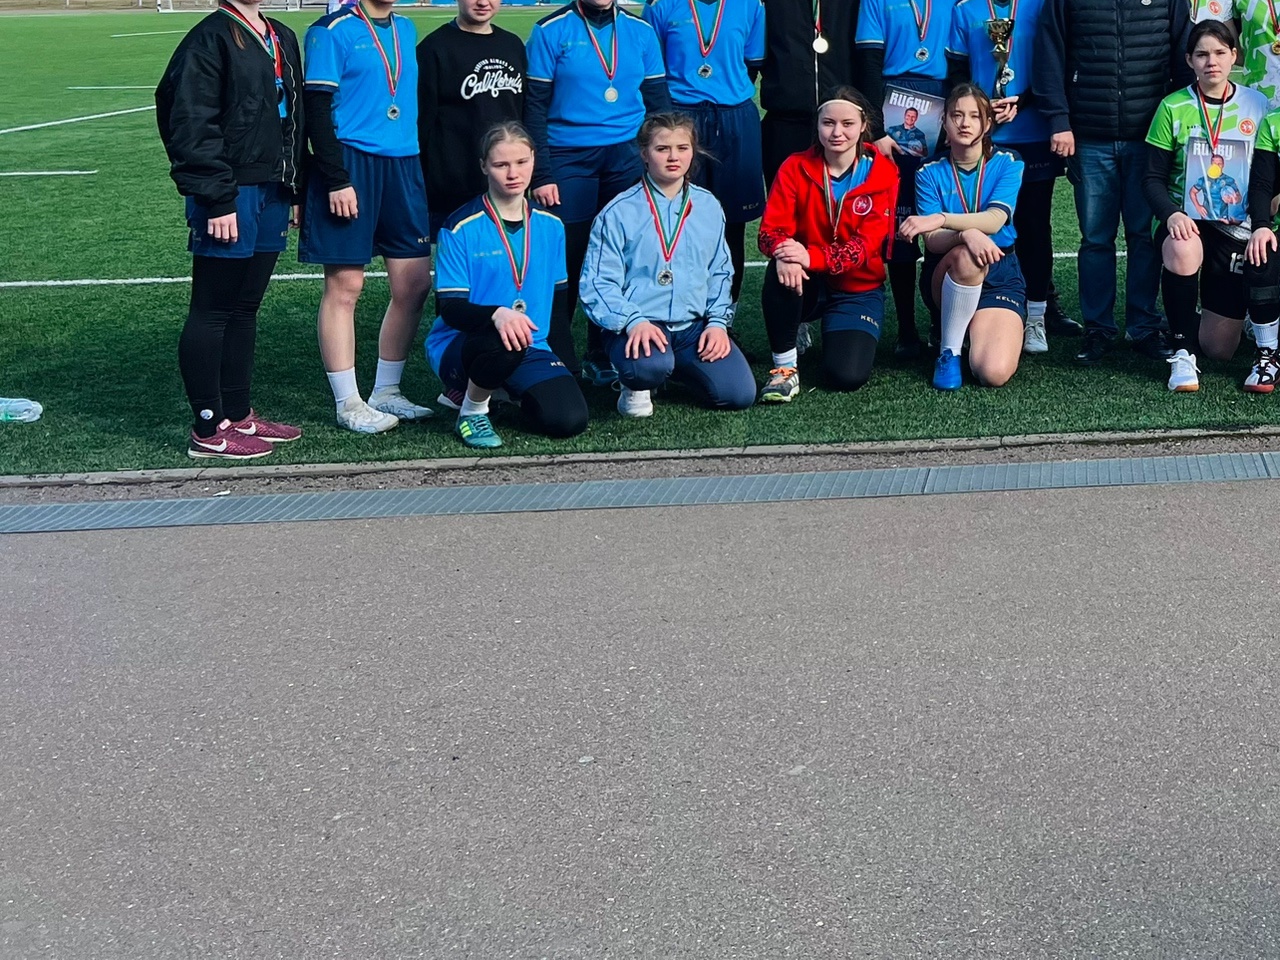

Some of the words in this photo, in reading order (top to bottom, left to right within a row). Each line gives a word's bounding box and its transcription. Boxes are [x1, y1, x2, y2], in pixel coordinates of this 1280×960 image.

[889, 92, 930, 115] RUGBY
[1193, 142, 1233, 160] RUBY
[1229, 252, 1245, 275] 12
